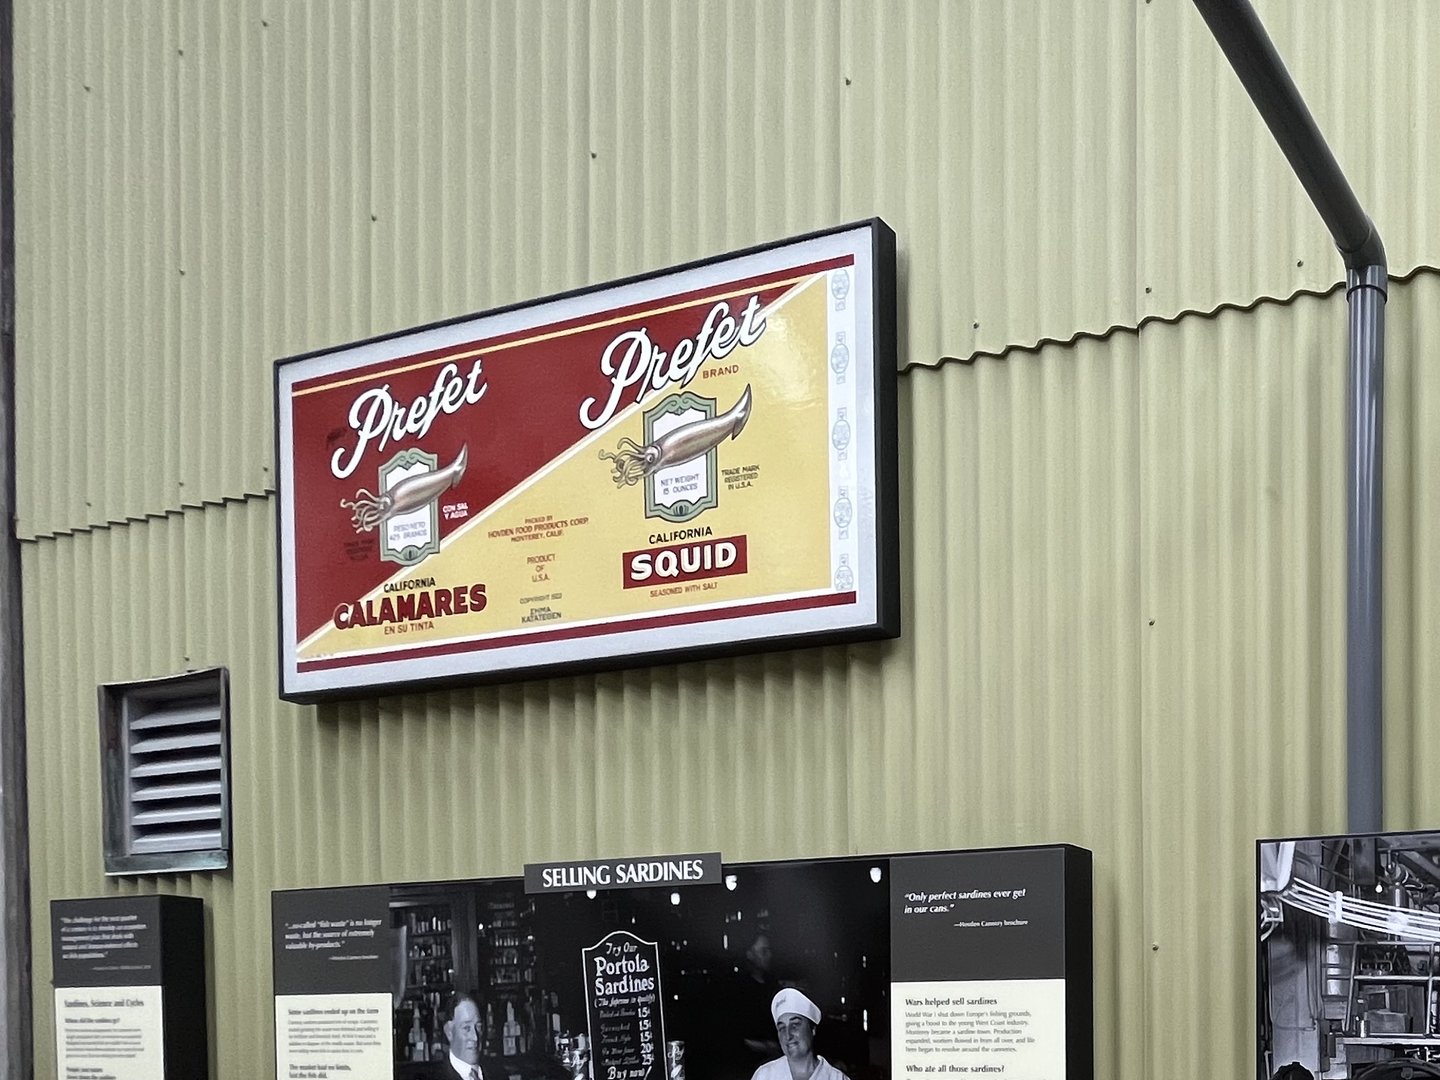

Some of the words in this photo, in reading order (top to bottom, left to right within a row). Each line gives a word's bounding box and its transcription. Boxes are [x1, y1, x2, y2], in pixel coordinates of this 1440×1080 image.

[579, 295, 767, 430] Prefet
[703, 365, 739, 379] BRAND
[331, 359, 488, 479] Prefet
[721, 467, 740, 475] TRADE
[673, 483, 697, 493] OUNCES
[515, 526, 532, 534] FOOD
[534, 520, 568, 531] PRODUCTS
[649, 527, 713, 544] CALIFORNIA
[527, 554, 555, 564] PRODUCT
[631, 541, 737, 581] SQUID
[536, 565, 544, 573] OF
[384, 577, 436, 593] CALIFORNIA
[685, 584, 700, 593] WITH
[332, 583, 487, 630] CALAMARES
[384, 626, 395, 634] EN
[398, 624, 408, 633] SU
[410, 622, 434, 632] TINTA
[542, 865, 610, 888] SELLING
[616, 860, 703, 883] SARDINES
[928, 891, 956, 903] perfect
[958, 890, 991, 899] sardines
[993, 890, 1011, 898] ever
[1012, 889, 1026, 899] get
[904, 905, 912, 913] in
[594, 953, 650, 976] Portola
[595, 975, 654, 995] Sardines
[905, 998, 923, 1006] Wars
[925, 998, 950, 1008] helped
[952, 997, 964, 1005] sell
[966, 997, 997, 1005] sardines
[906, 1065, 922, 1073] Who
[938, 1065, 947, 1073] all
[949, 1065, 968, 1073] those
[970, 1065, 1005, 1073] sardines?
